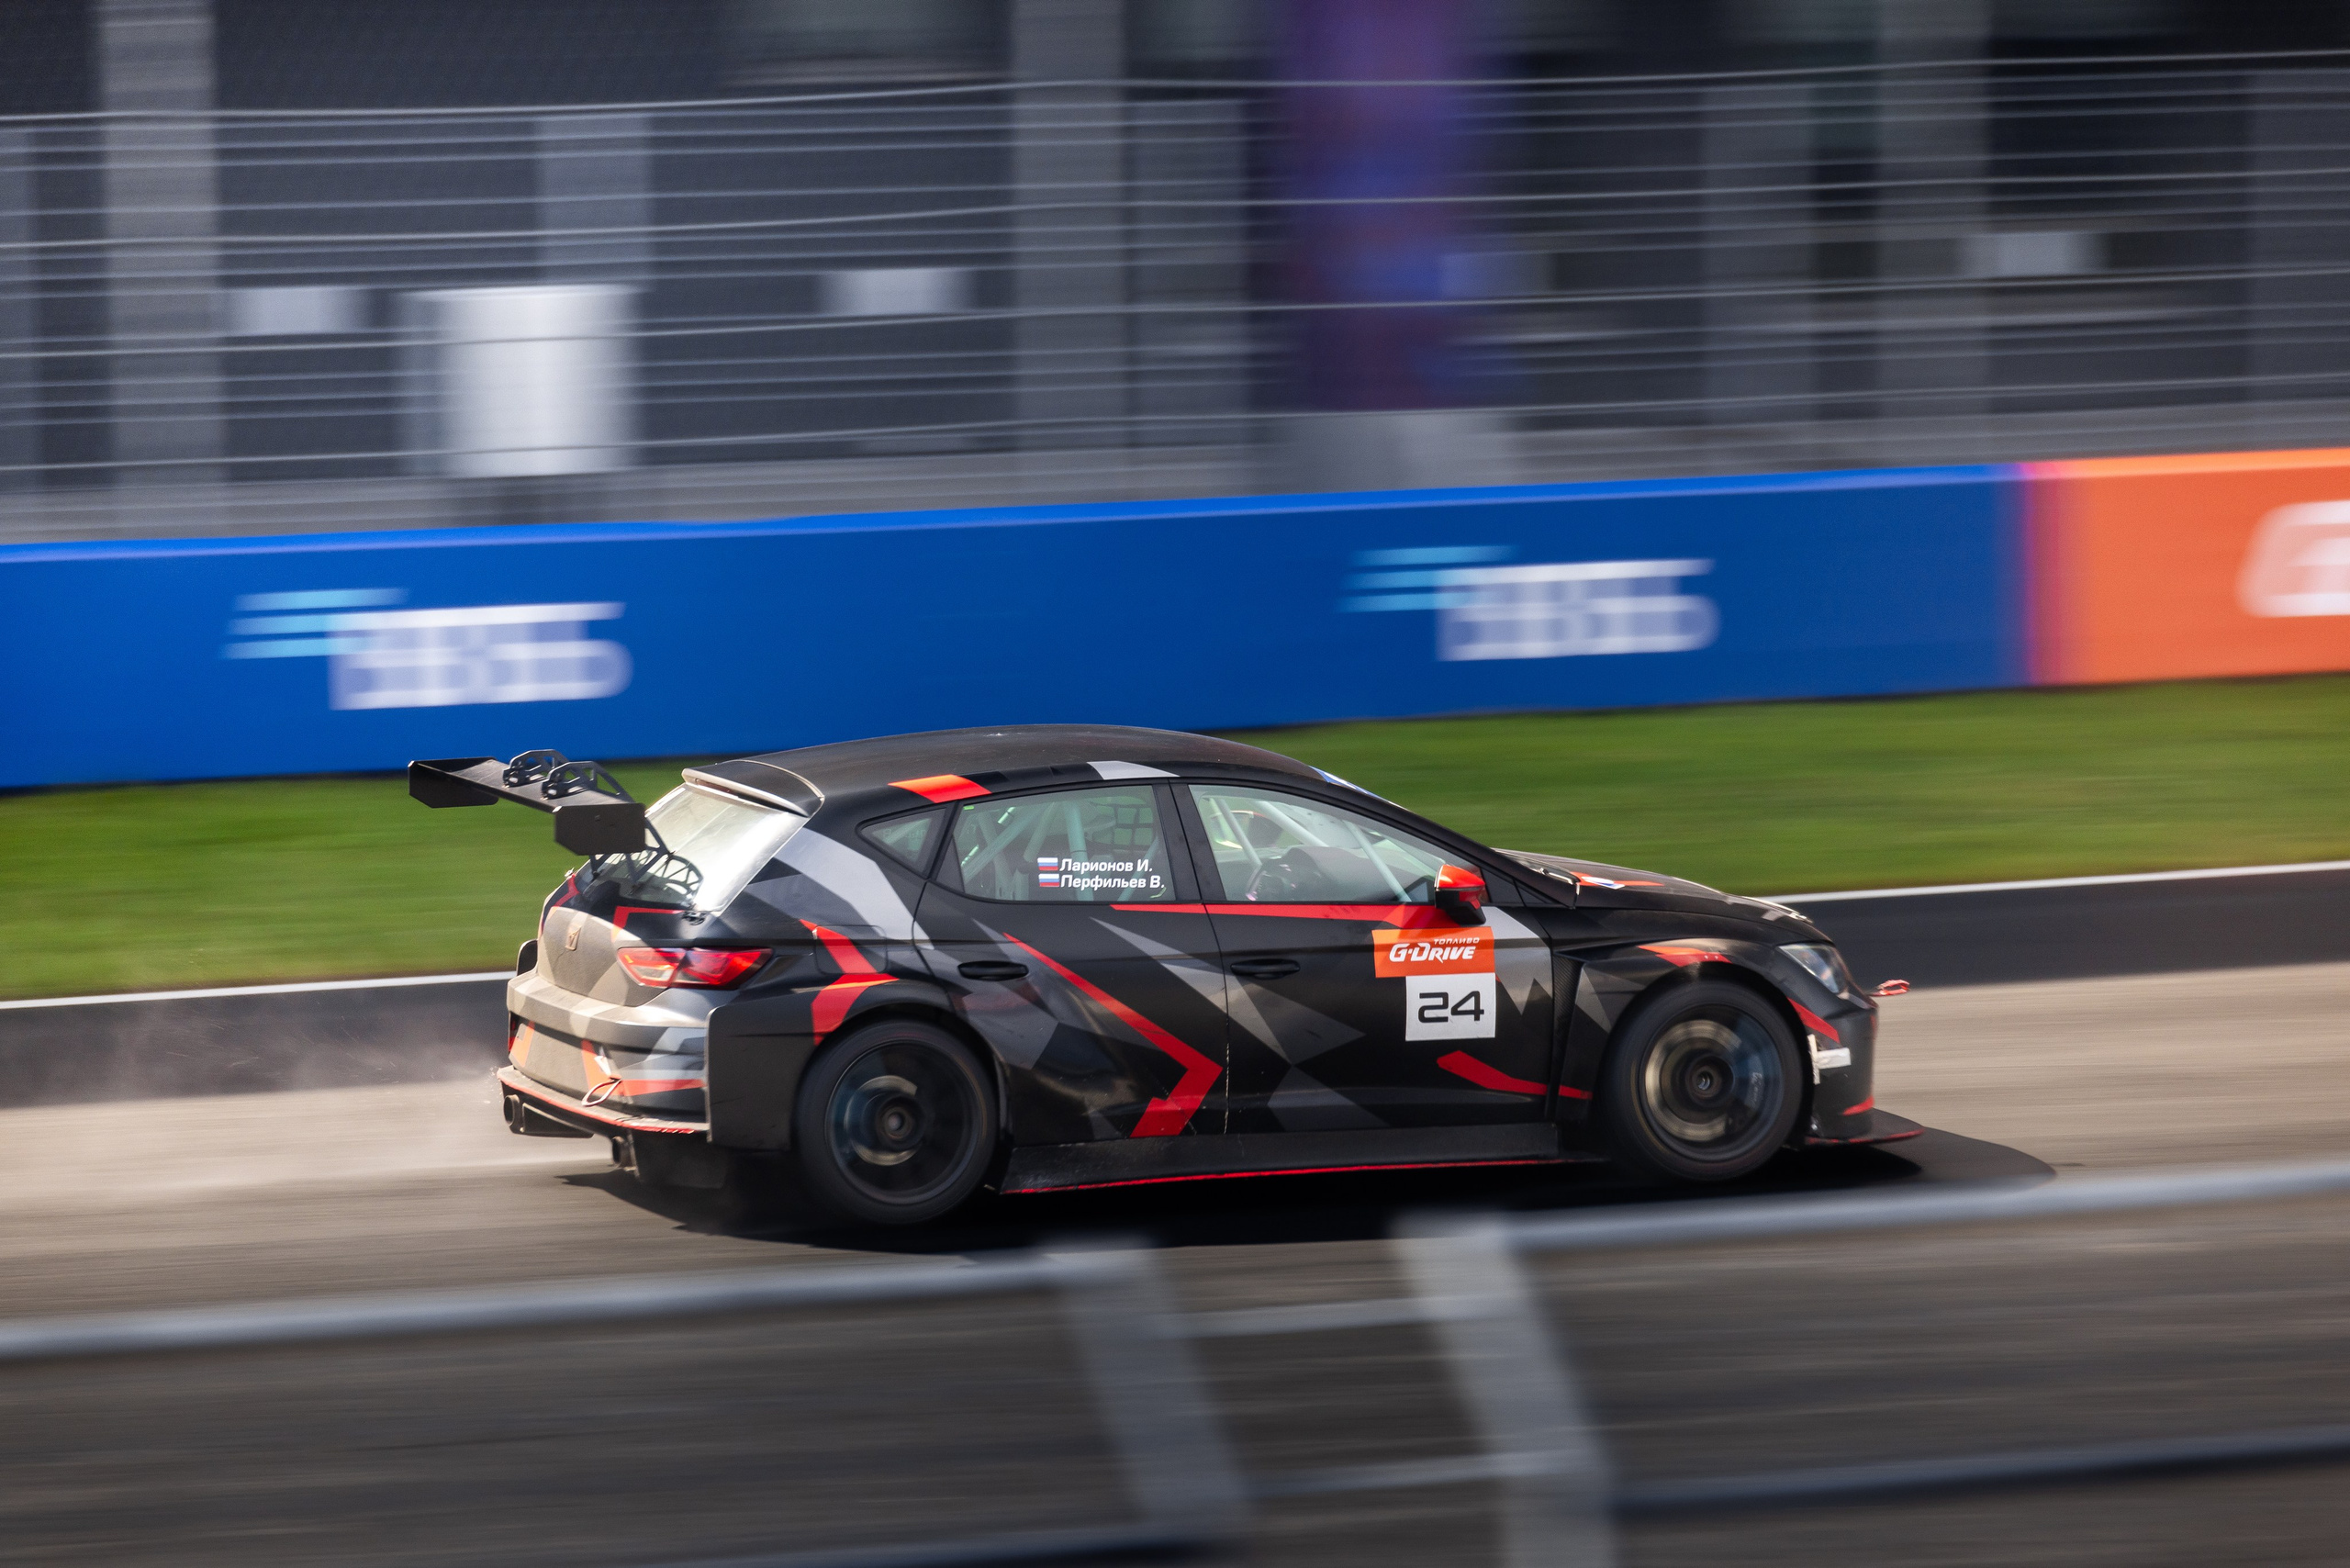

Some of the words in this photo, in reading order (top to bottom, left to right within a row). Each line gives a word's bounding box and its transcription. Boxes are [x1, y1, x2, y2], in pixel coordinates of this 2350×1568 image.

[1059, 858, 1134, 875] Ларионов
[1136, 858, 1153, 872] И.
[1060, 874, 1147, 891] Перфильев
[1149, 875, 1165, 889] В.
[1434, 936, 1481, 946] ТОПЛИВО
[1418, 991, 1485, 1024] 24
